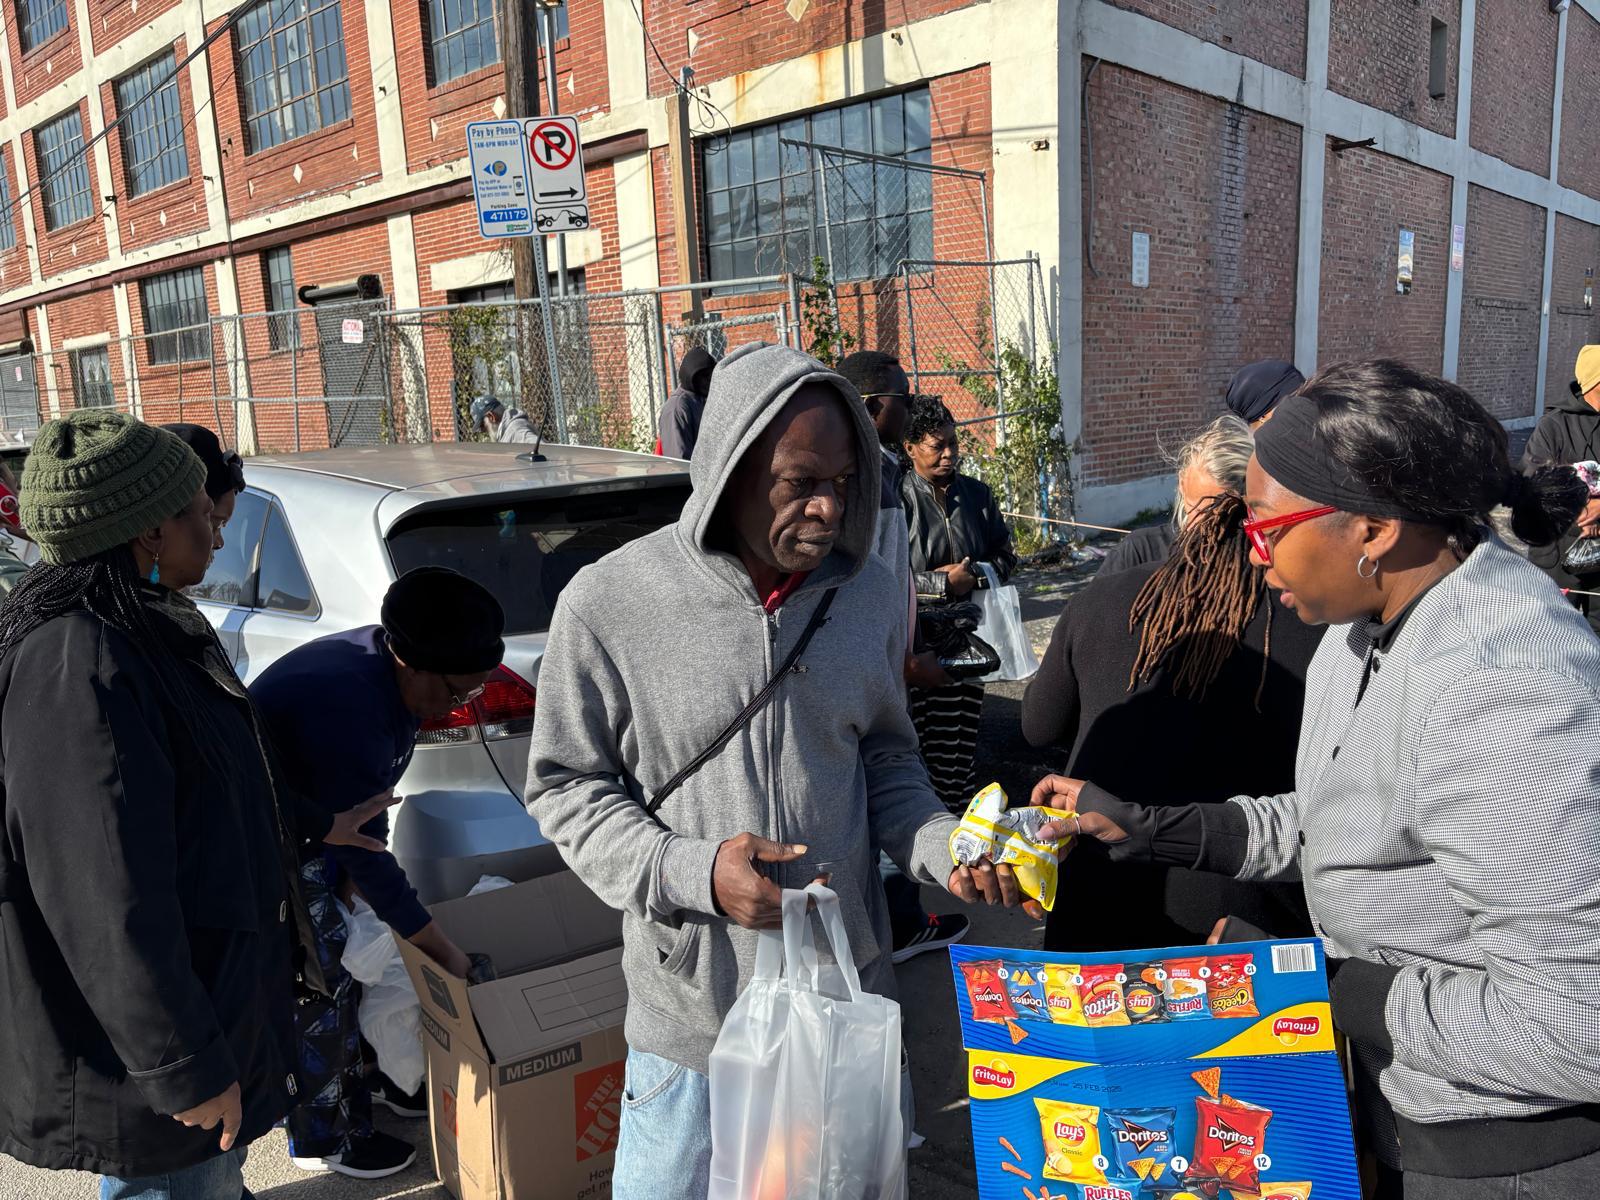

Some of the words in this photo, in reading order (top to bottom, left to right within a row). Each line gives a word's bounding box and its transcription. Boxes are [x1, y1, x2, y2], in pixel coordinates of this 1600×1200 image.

[472, 128, 484, 138] Pay
[486, 127, 494, 138] by
[496, 126, 518, 136] Phone
[490, 210, 527, 220] 471179
[975, 994, 1003, 1002] Doritos
[1011, 996, 1042, 1007] Doritos
[1084, 990, 1121, 1016] Fritos
[1212, 988, 1250, 1012] Cheetos
[1167, 998, 1203, 1012] RUFFLES
[506, 1048, 576, 1081] MEDIUM
[584, 1074, 618, 1112] THE
[1072, 1082, 1082, 1090] 25
[1085, 1083, 1100, 1092] FEB
[1101, 1085, 1122, 1093] 2025
[1056, 1122, 1084, 1140] Lay's
[1119, 1130, 1168, 1142] Doritos
[1209, 1126, 1254, 1146] Doritos
[1062, 1148, 1082, 1156] Classic
[1098, 1158, 1104, 1168] 8
[1176, 1160, 1182, 1170] 7
[1256, 1157, 1267, 1168] 12
[1084, 1186, 1132, 1200] RUFFLES
